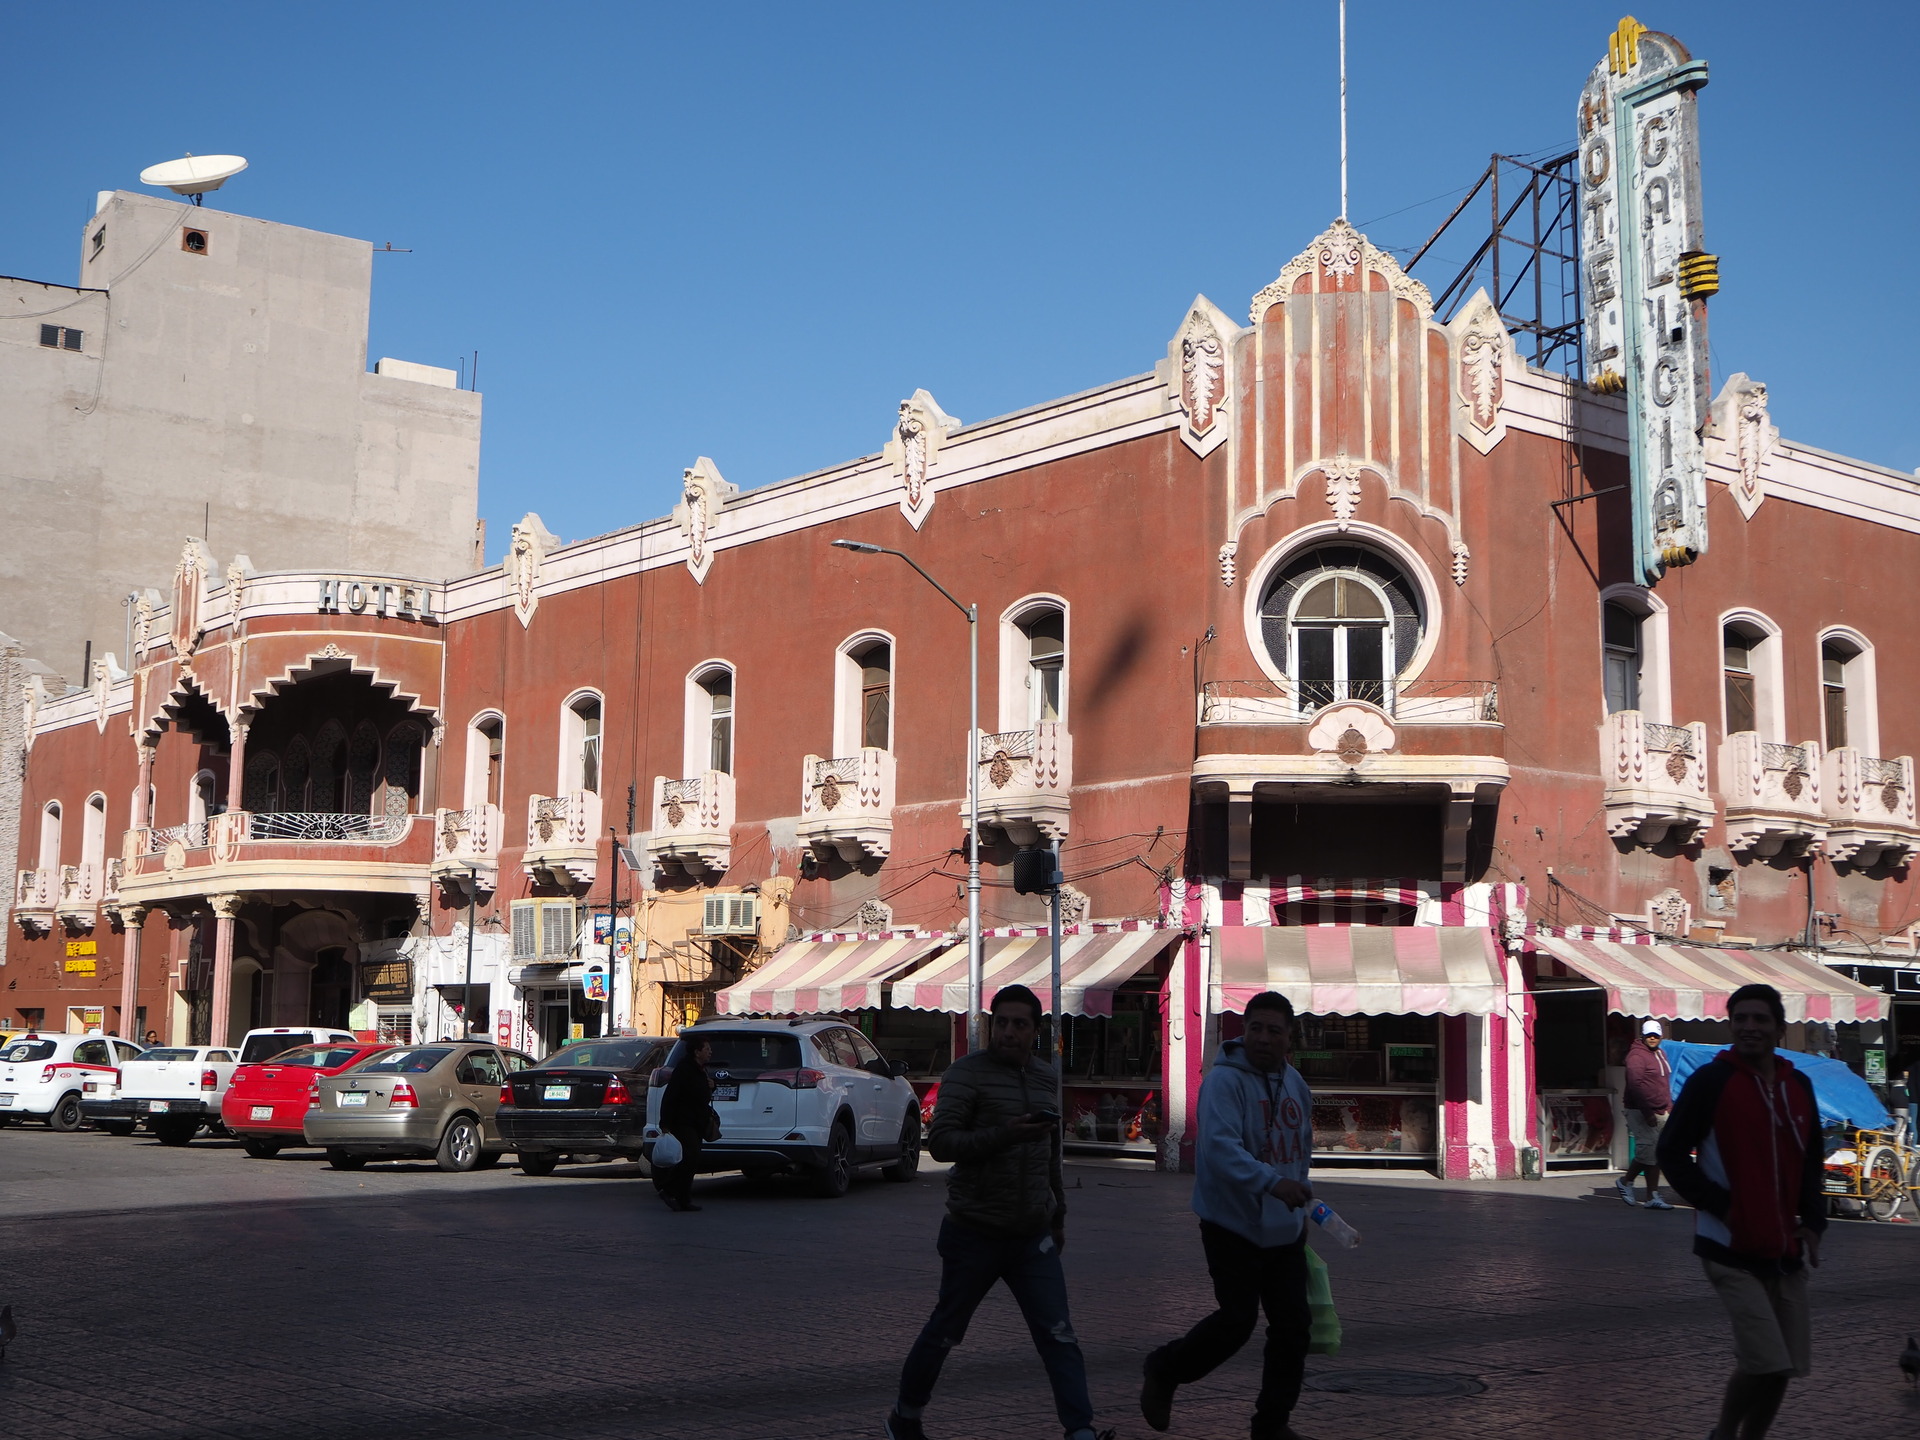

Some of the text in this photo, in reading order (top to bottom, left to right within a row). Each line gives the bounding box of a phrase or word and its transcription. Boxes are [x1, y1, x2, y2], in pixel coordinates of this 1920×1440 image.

[1581, 84, 1618, 364] HOTEL
[1641, 115, 1685, 536] GALICIA
[318, 579, 438, 620] HOTEL
[1867, 1058, 1881, 1071] 15
